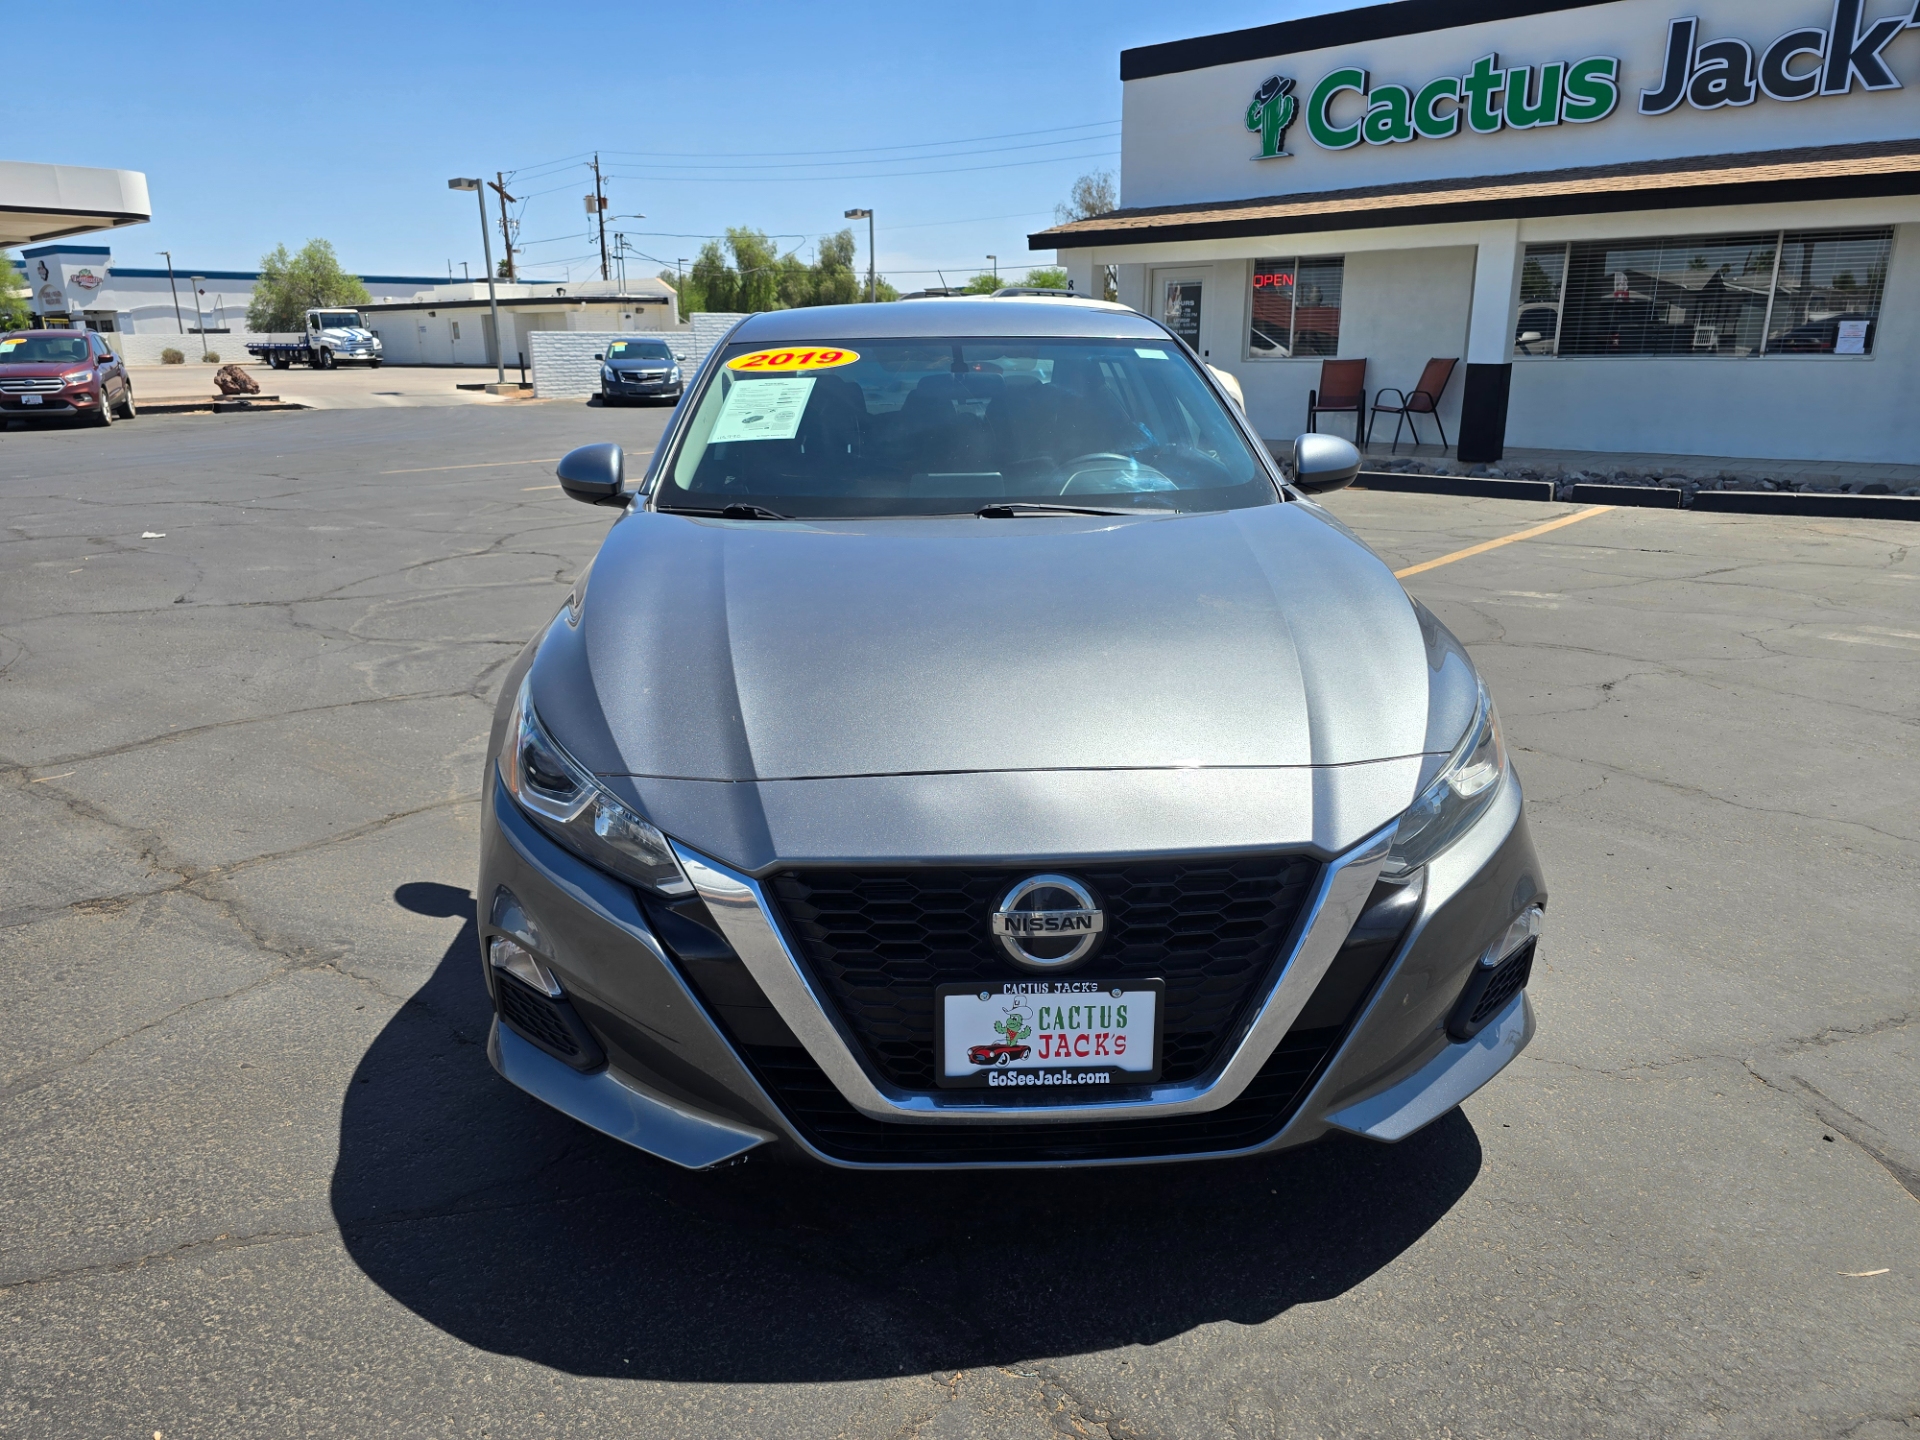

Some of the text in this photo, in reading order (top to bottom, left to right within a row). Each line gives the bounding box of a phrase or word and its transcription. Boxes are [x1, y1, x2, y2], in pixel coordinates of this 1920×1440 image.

[1307, 52, 1619, 151] Cactus
[1253, 273, 1294, 288] OPEN
[739, 351, 844, 369] 2019
[1004, 915, 1092, 932] NISSAN
[1003, 982, 1098, 995] CACTUS JACK'S
[1038, 1004, 1128, 1031] CACTUS
[1038, 1032, 1127, 1060] JACK'S
[988, 1069, 1110, 1087] GoSeeJack.com
